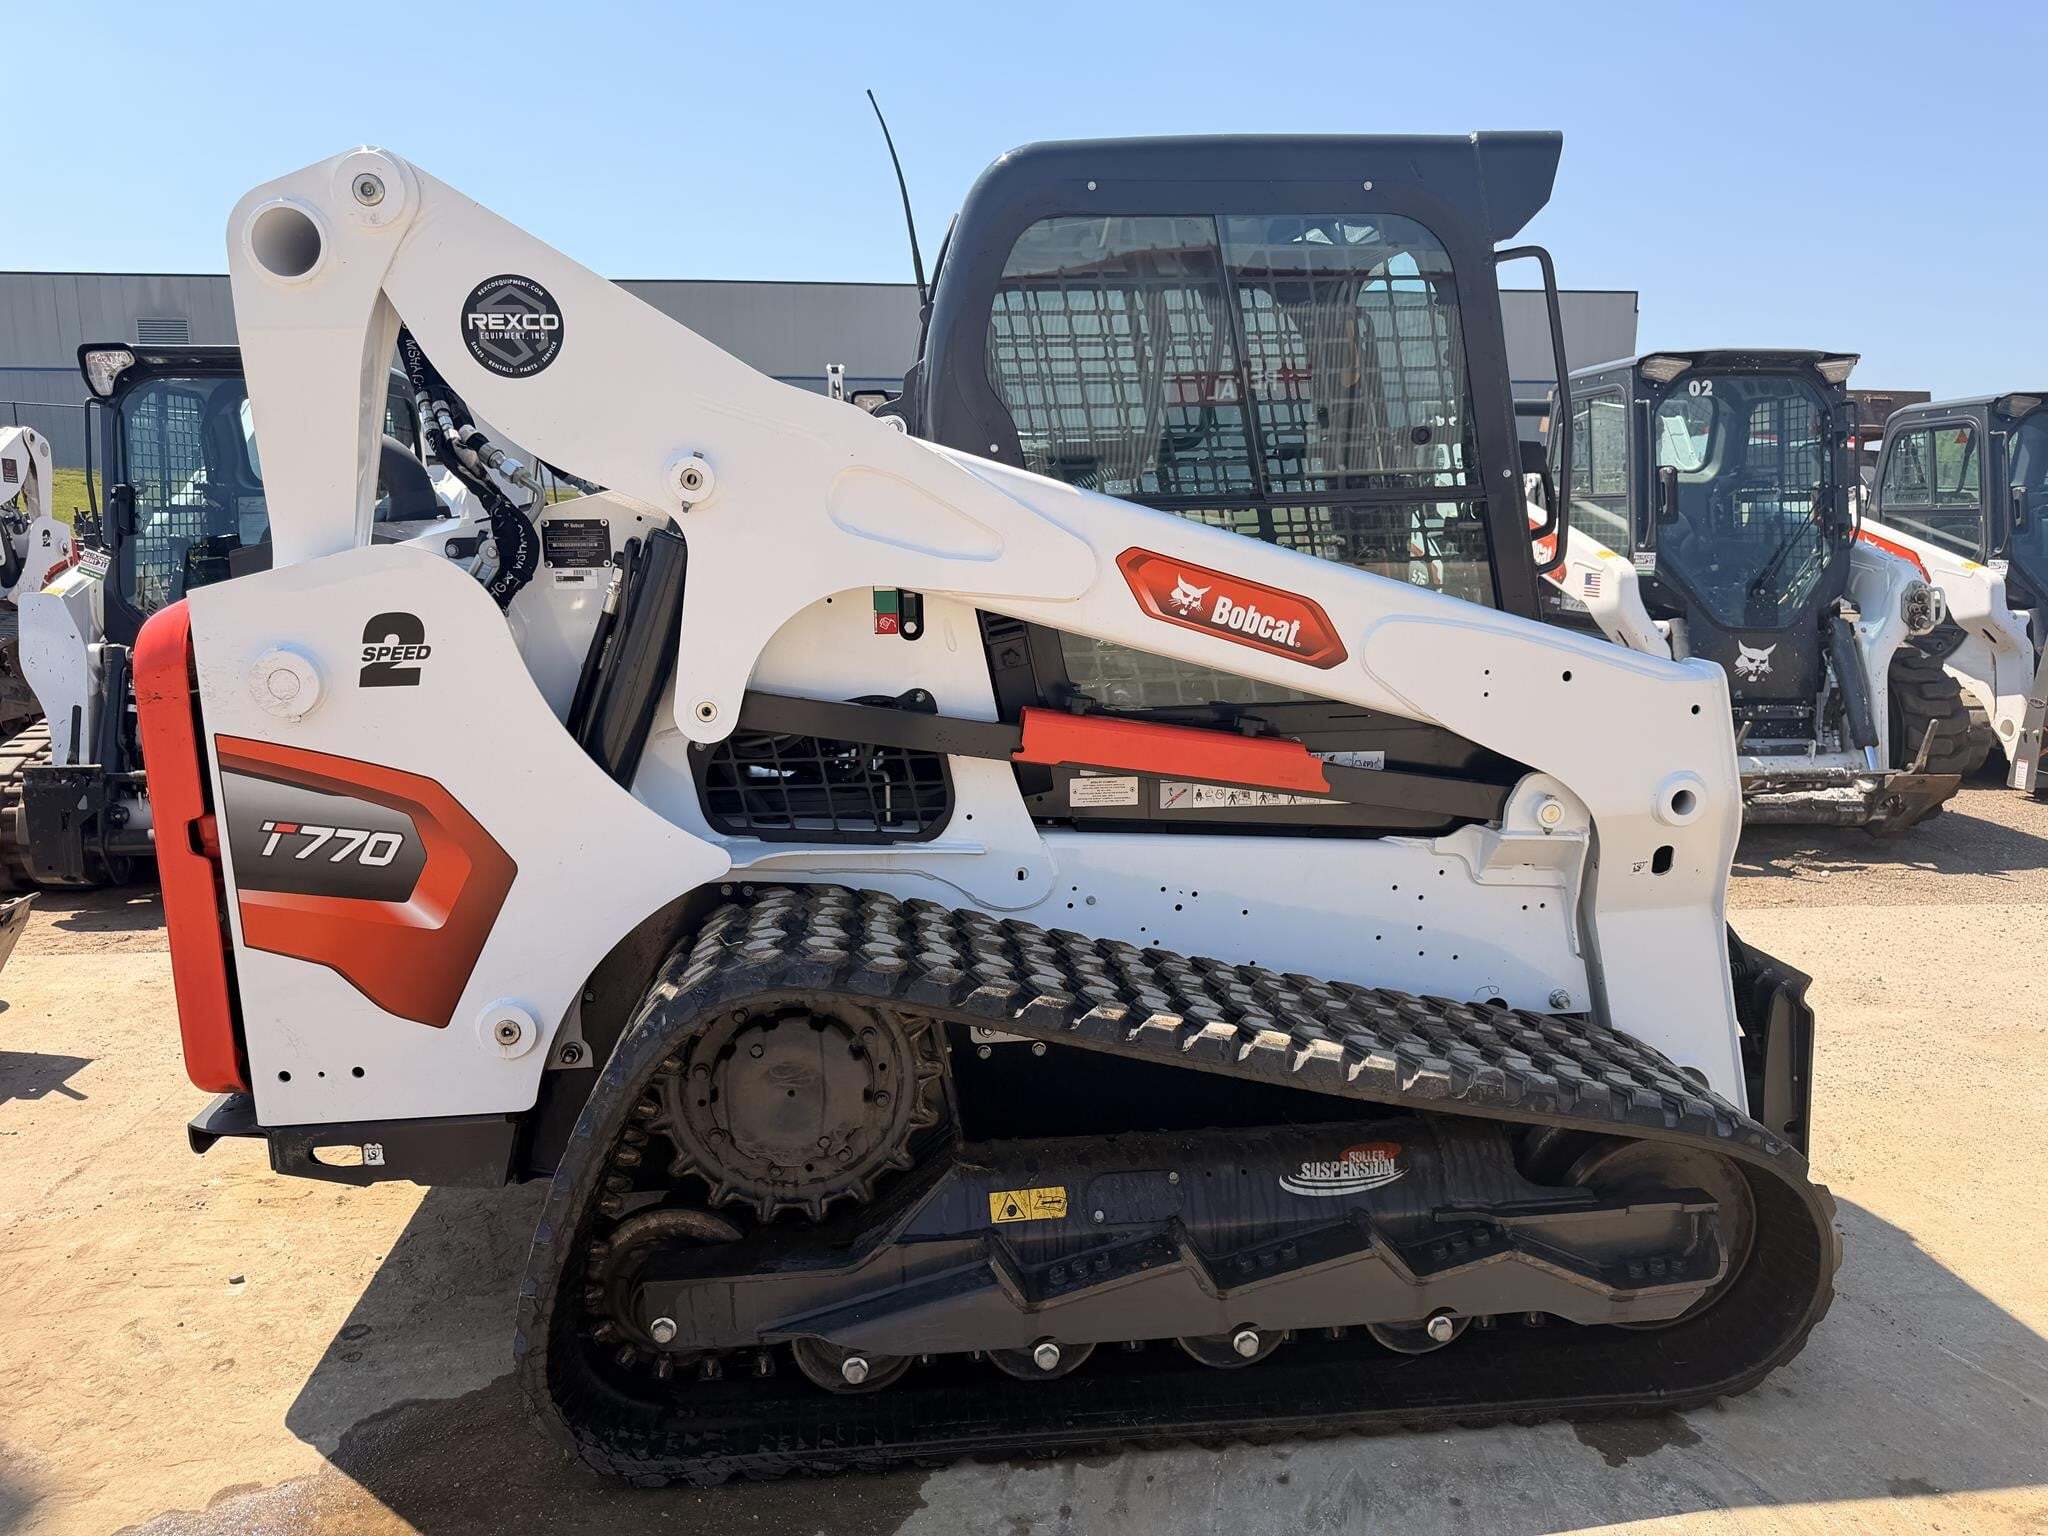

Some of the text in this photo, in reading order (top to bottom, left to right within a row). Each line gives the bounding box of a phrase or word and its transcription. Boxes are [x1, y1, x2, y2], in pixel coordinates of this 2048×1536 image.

[477, 279, 544, 297] REXCOEQUIPMENT.COM
[467, 313, 559, 330] REXCO
[531, 332, 548, 340] INC.
[470, 341, 558, 373] SALES RENTALS PARTS SERVICE
[1688, 380, 1713, 397] 02
[1210, 595, 1301, 647] Bobcat
[359, 612, 425, 688] 2
[361, 645, 432, 662] SPEED
[261, 820, 404, 867] T770
[1348, 1150, 1386, 1164] ROLLER
[1300, 1159, 1395, 1180] SUSPENSION
